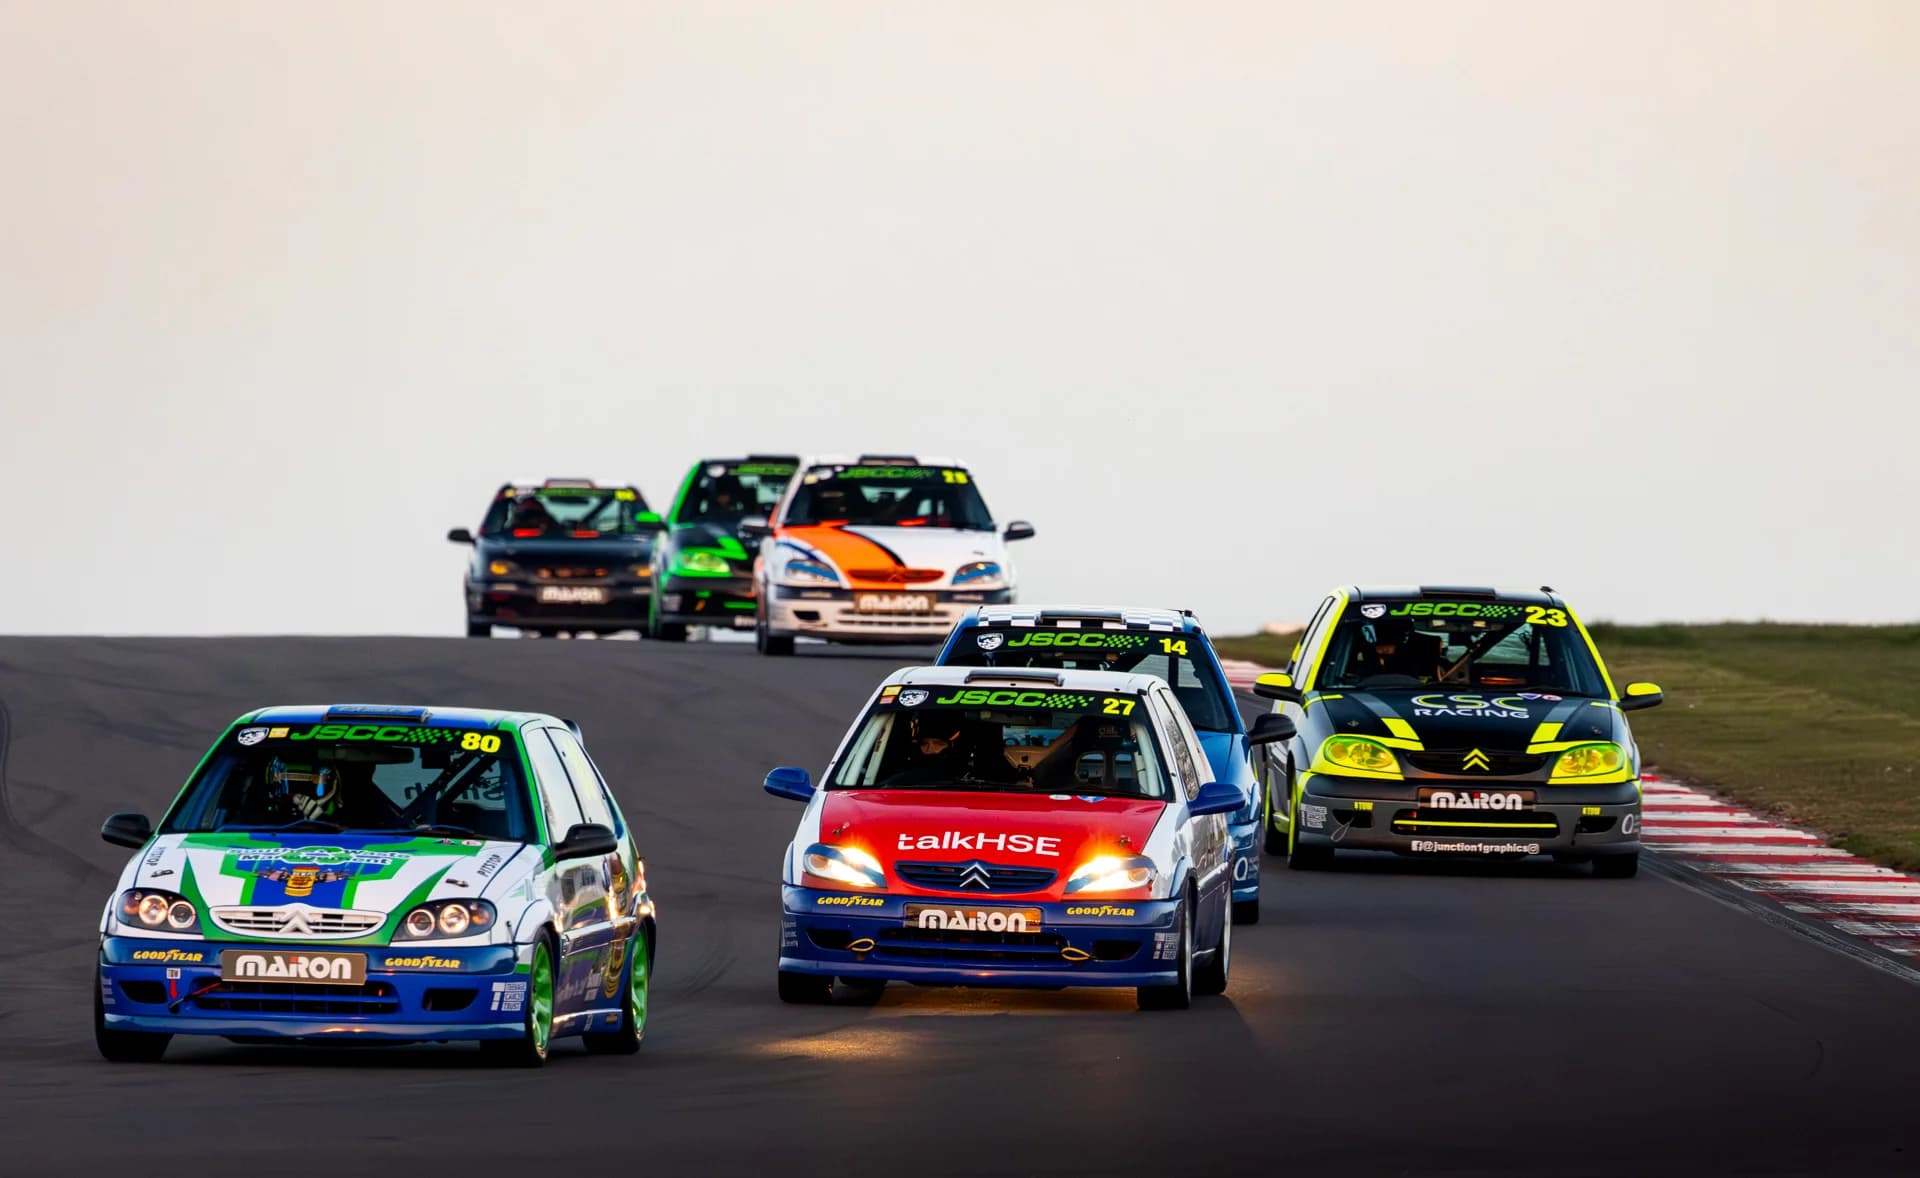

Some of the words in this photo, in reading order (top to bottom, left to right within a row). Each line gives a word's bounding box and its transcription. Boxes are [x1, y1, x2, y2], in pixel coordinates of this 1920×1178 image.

[1390, 602, 1482, 617] JSCC
[1525, 605, 1569, 628] 23
[1007, 632, 1106, 648] JSCC
[1159, 638, 1188, 656] 14
[936, 690, 1046, 708] JSCC
[1103, 698, 1136, 717] 27
[1411, 694, 1529, 712] CSC
[1414, 708, 1530, 719] RACING
[290, 724, 409, 742] JSCC
[460, 732, 501, 753] 80
[897, 831, 1062, 857] talkHSE
[817, 895, 885, 908] GOODYEAR
[1066, 905, 1136, 918] GOODYEAR
[133, 949, 204, 963] GOODYEAR
[384, 955, 461, 970] GOODYEAR
